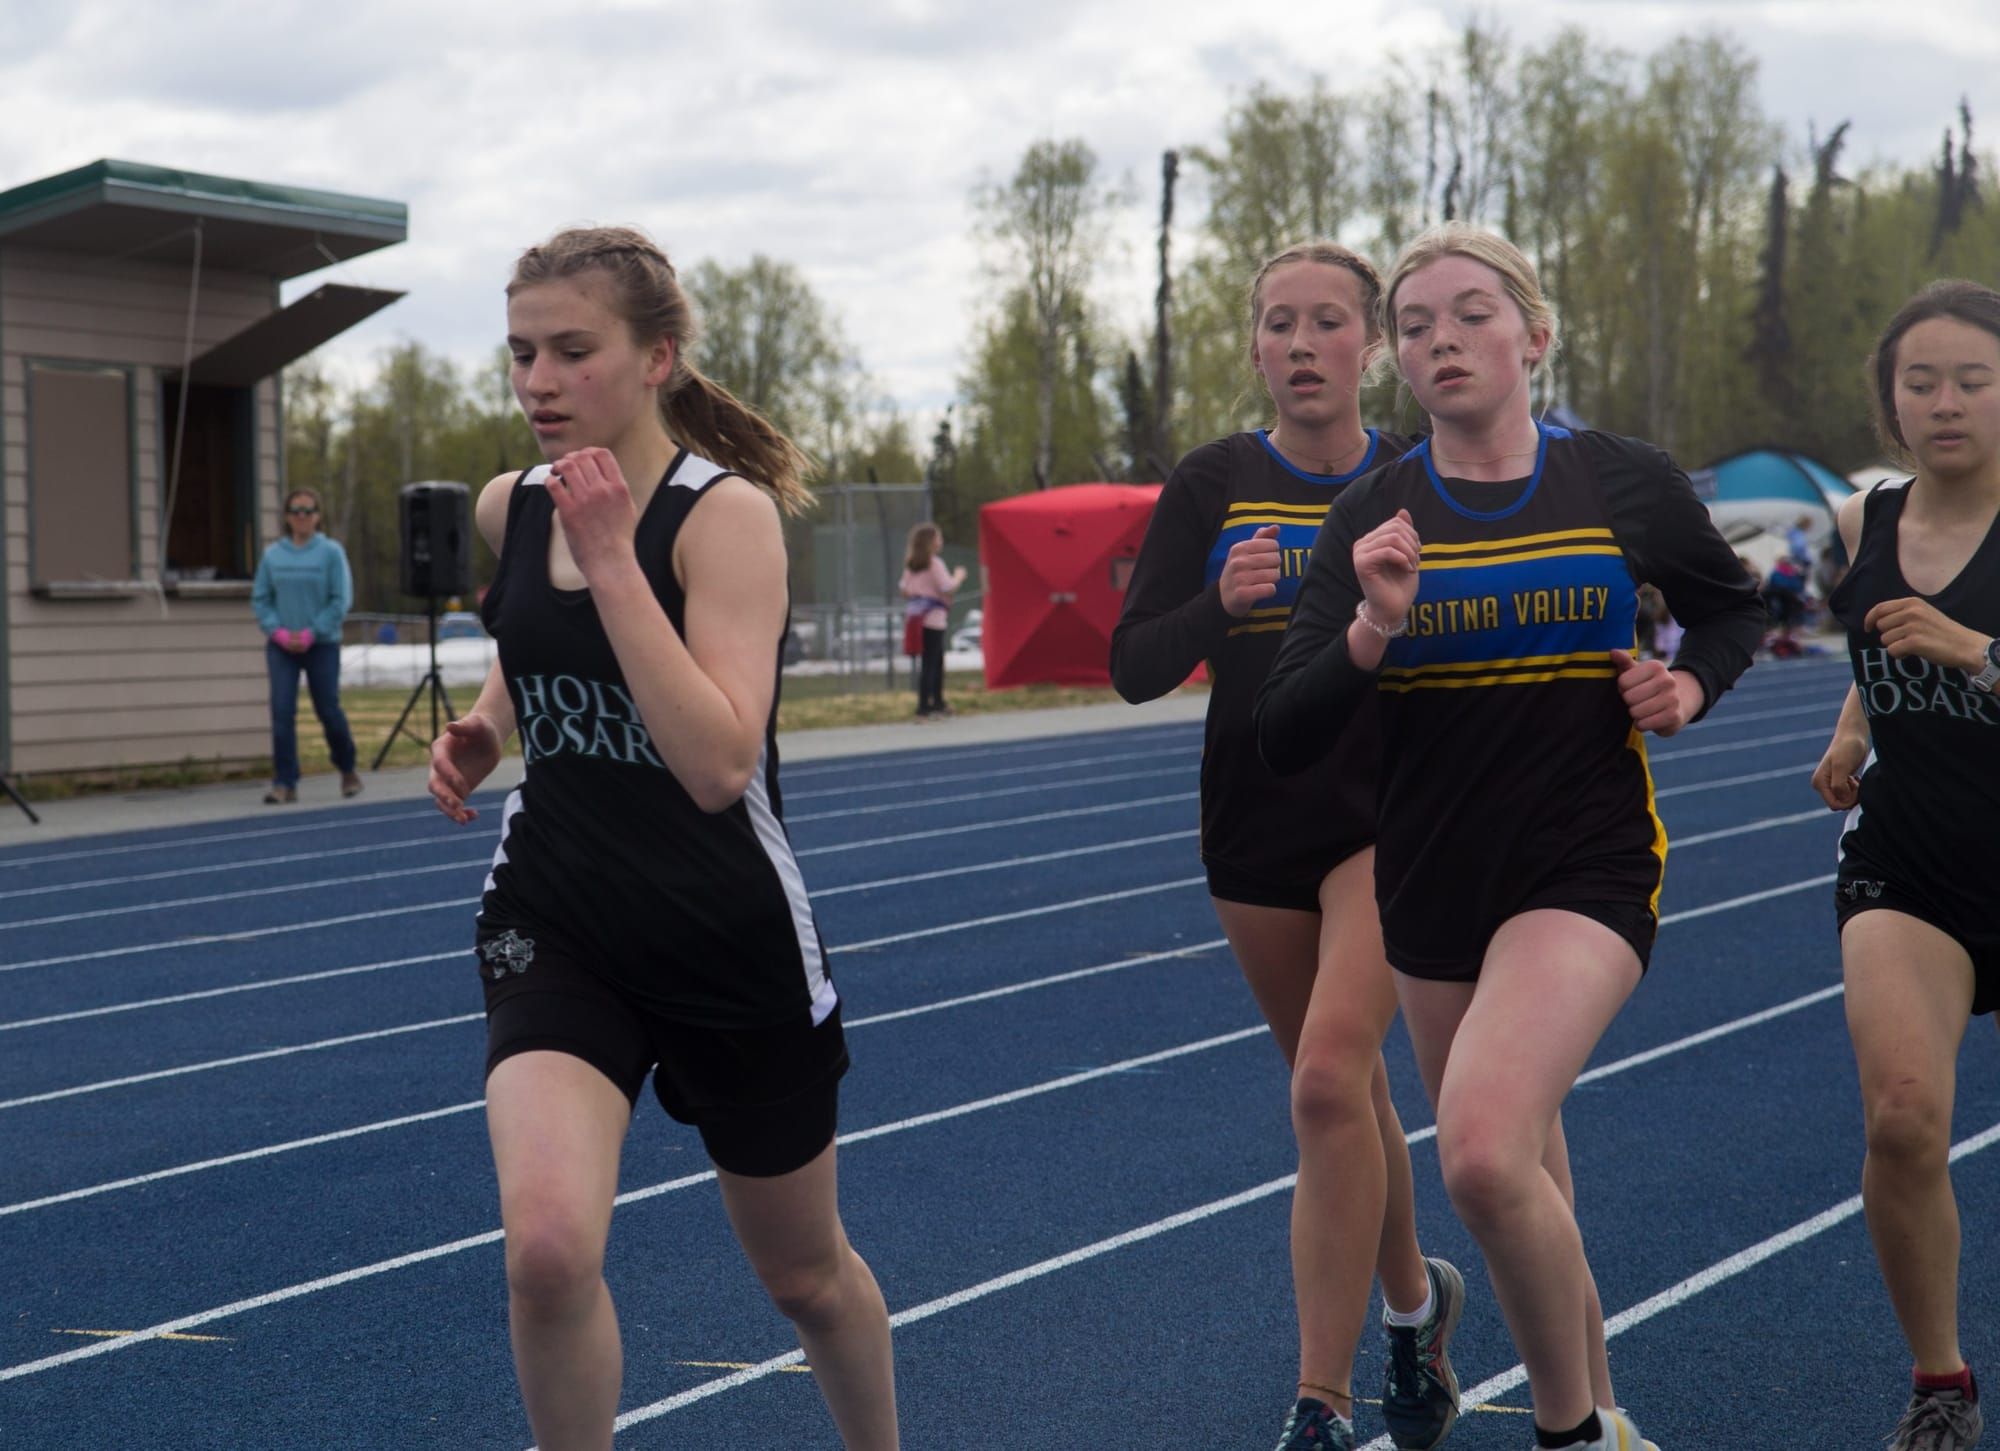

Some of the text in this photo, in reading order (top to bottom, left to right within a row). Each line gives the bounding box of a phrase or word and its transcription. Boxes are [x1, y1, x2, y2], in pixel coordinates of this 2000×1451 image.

[1407, 586, 1609, 637] USITNA VALLEY
[1859, 681, 2000, 726] ROSAR
